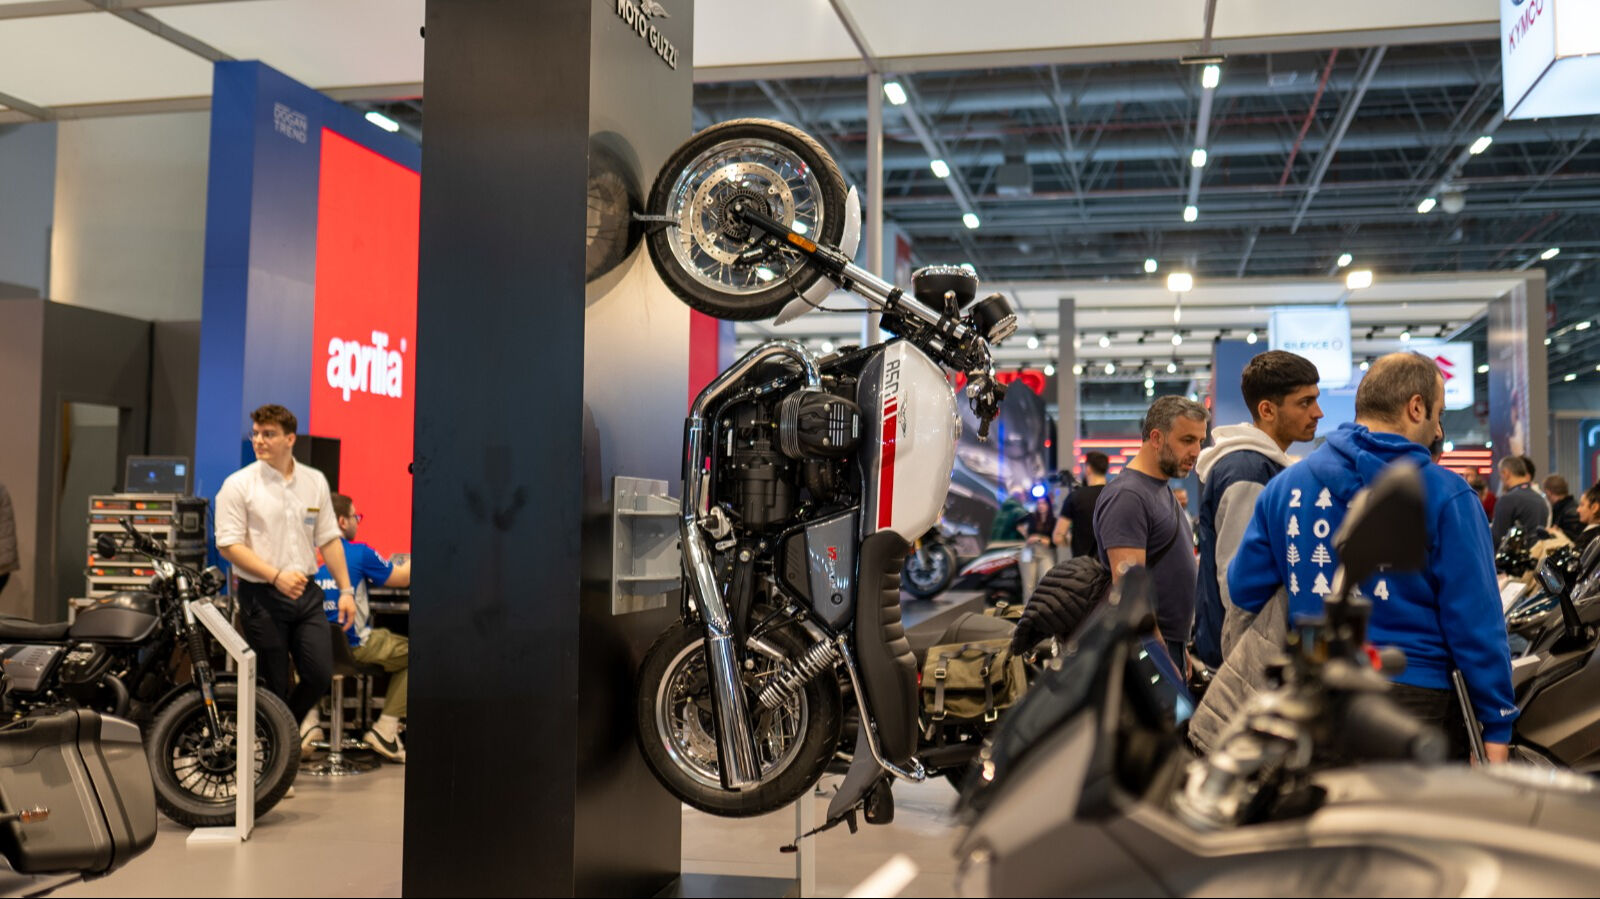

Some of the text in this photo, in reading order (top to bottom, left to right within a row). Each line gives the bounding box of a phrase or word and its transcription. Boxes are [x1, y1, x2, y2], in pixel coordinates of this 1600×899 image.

[617, 0, 677, 70] MOTO GUZZI
[326, 330, 403, 402] aprilia
[1288, 488, 1302, 508] 2
[1373, 579, 1390, 601] 4
